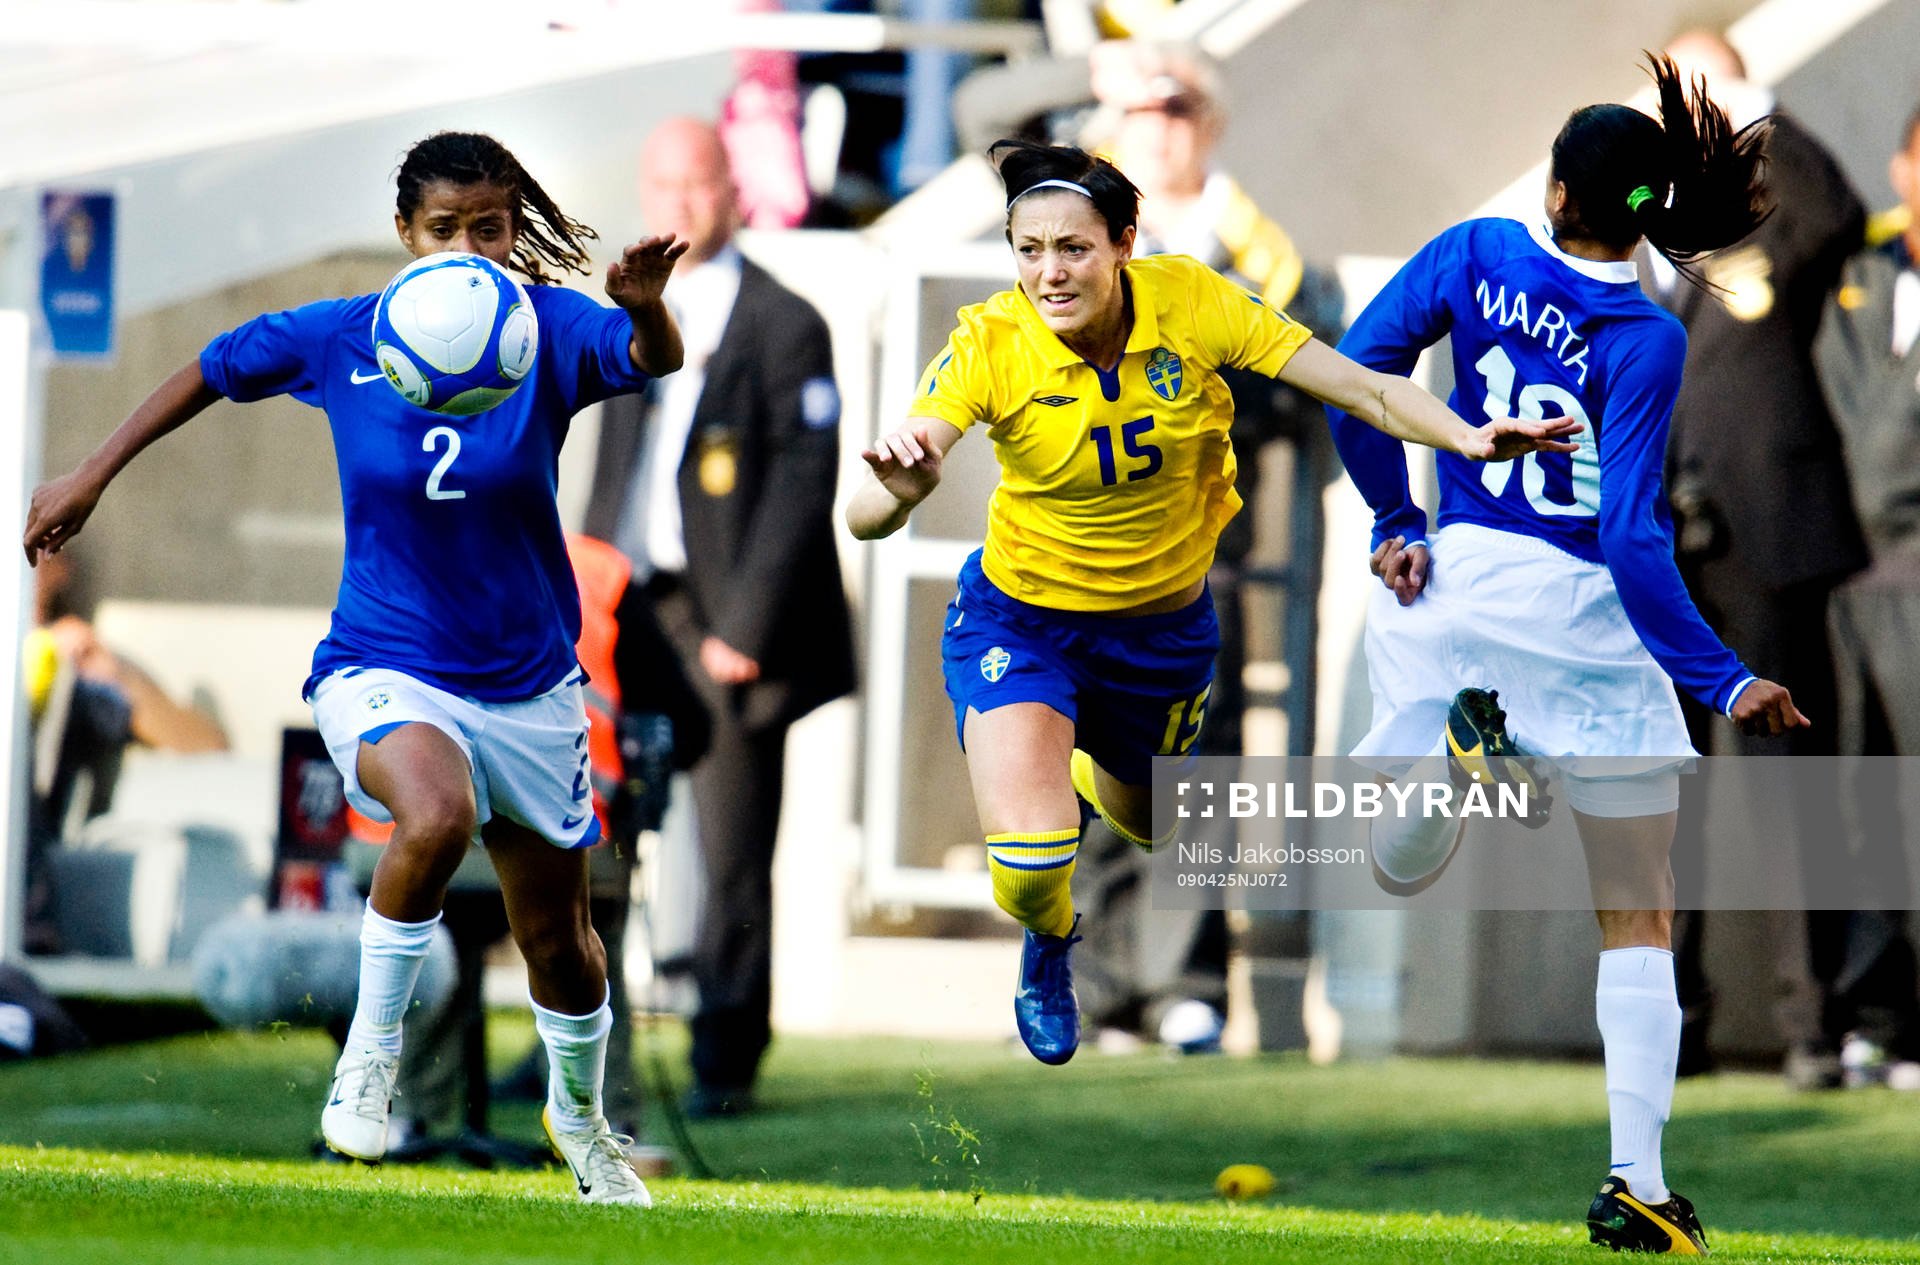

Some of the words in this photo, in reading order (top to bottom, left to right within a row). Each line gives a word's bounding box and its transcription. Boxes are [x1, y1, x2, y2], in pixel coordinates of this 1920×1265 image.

[1476, 279, 1590, 386] MARTA
[422, 426, 466, 500] 2
[1090, 414, 1163, 487] 15
[1475, 345, 1601, 517] 10
[1157, 682, 1212, 755] 15
